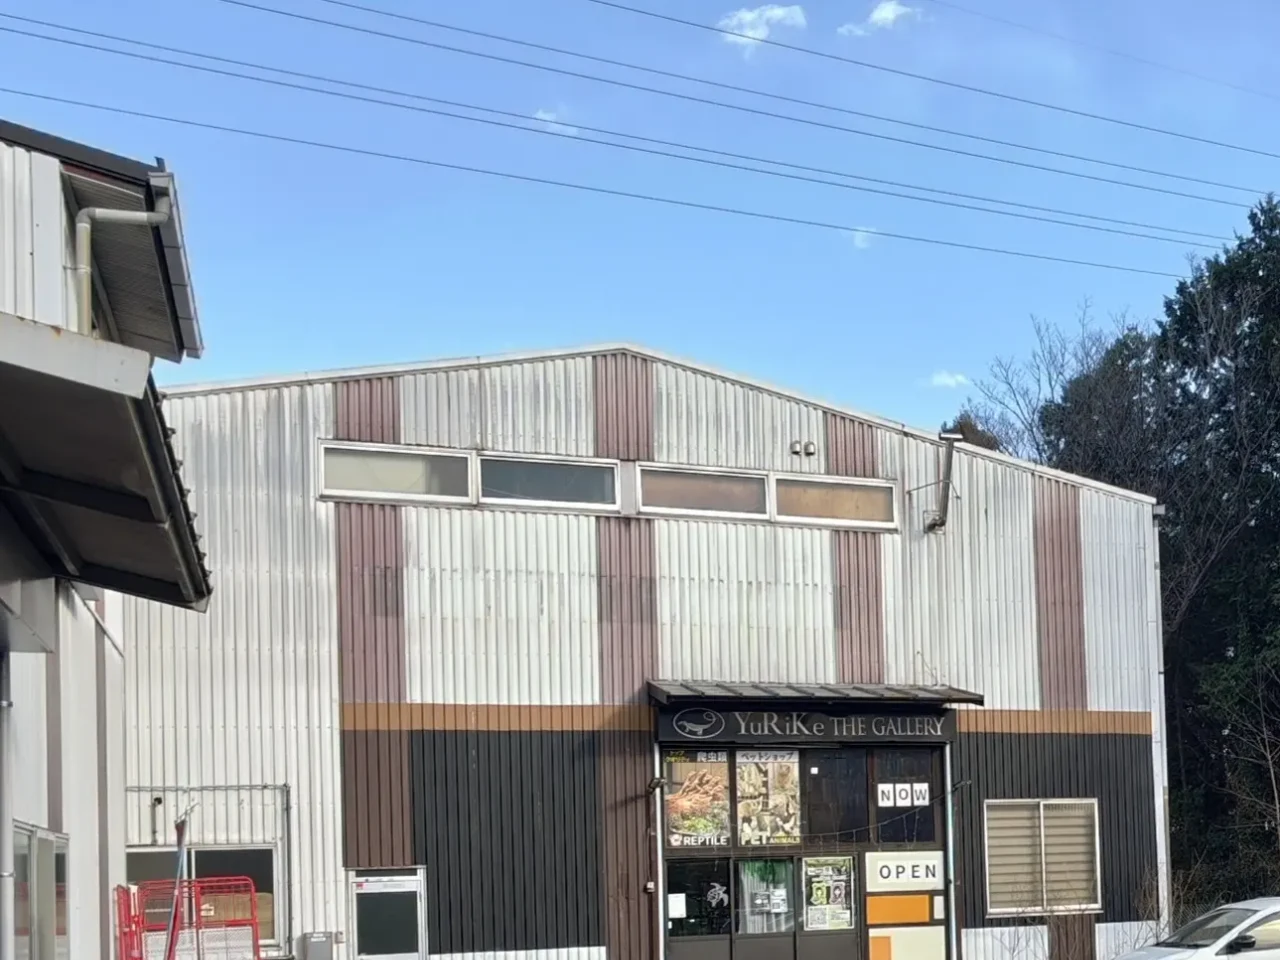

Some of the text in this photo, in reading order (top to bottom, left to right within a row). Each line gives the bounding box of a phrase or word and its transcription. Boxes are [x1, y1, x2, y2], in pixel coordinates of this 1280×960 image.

[734, 711, 945, 736] YuRiKe THE GALLERY
[741, 752, 794, 762] ペットショップ
[881, 788, 928, 802] NOW
[683, 836, 728, 846] REPTILE
[741, 833, 770, 846] PET
[879, 864, 937, 879] OPEN
